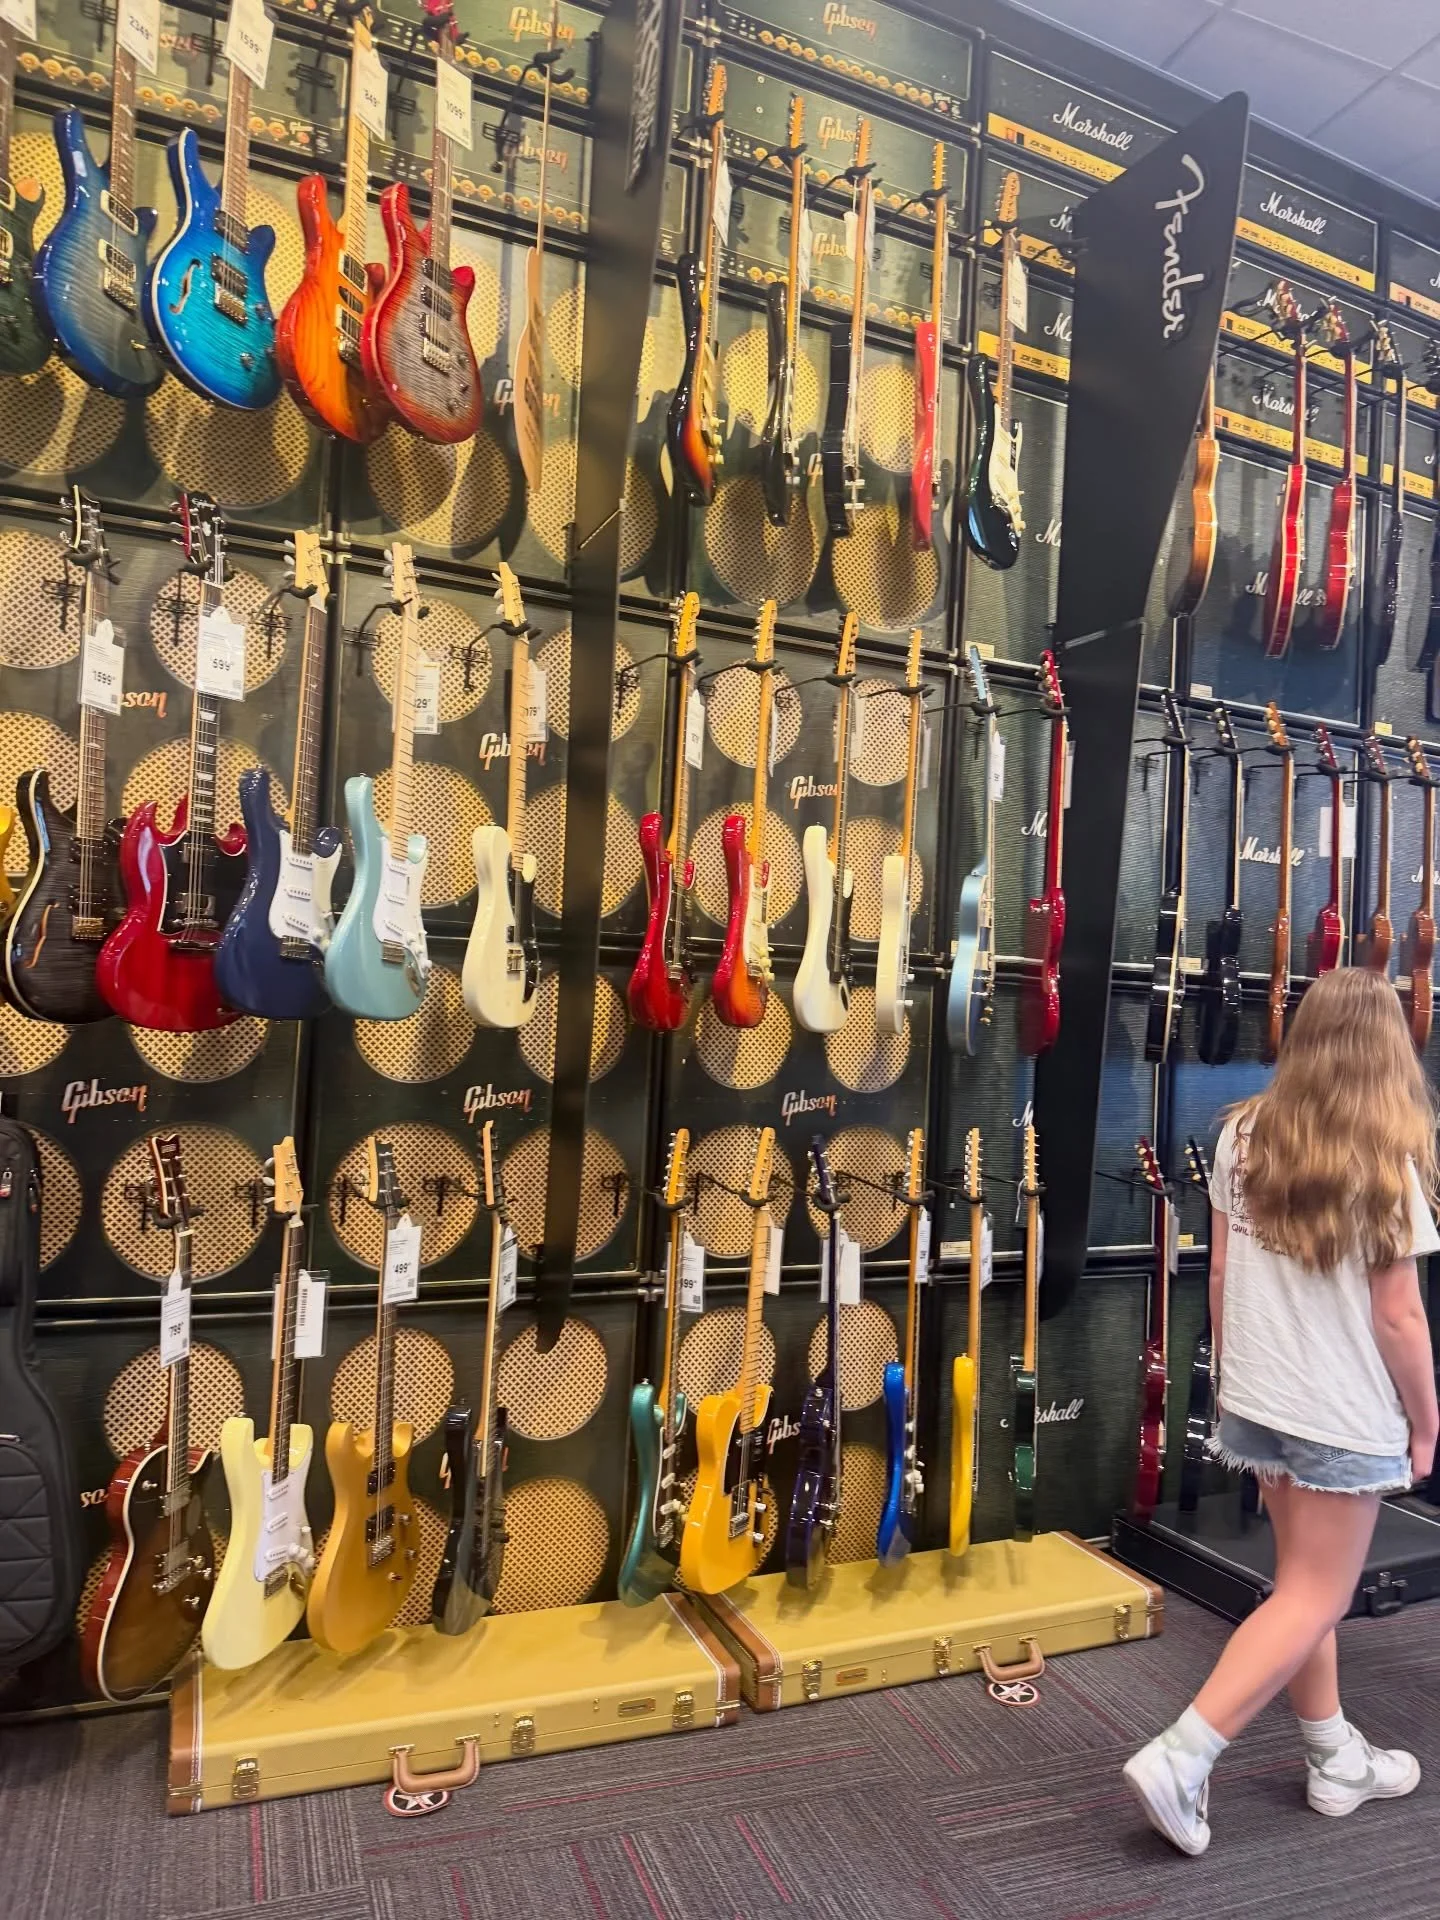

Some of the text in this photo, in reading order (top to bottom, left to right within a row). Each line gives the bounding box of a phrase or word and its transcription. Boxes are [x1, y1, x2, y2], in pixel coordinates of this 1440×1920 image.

[823, 2, 877, 41] Gibson
[1053, 102, 1133, 151] Marshall
[1260, 191, 1327, 235] Marshall
[1155, 154, 1204, 339] Fender
[122, 691, 167, 718] son
[790, 776, 838, 809] Gibso
[62, 1079, 147, 1123] Gibson
[463, 1084, 533, 1123] Gibson
[781, 1090, 837, 1126] Gibson
